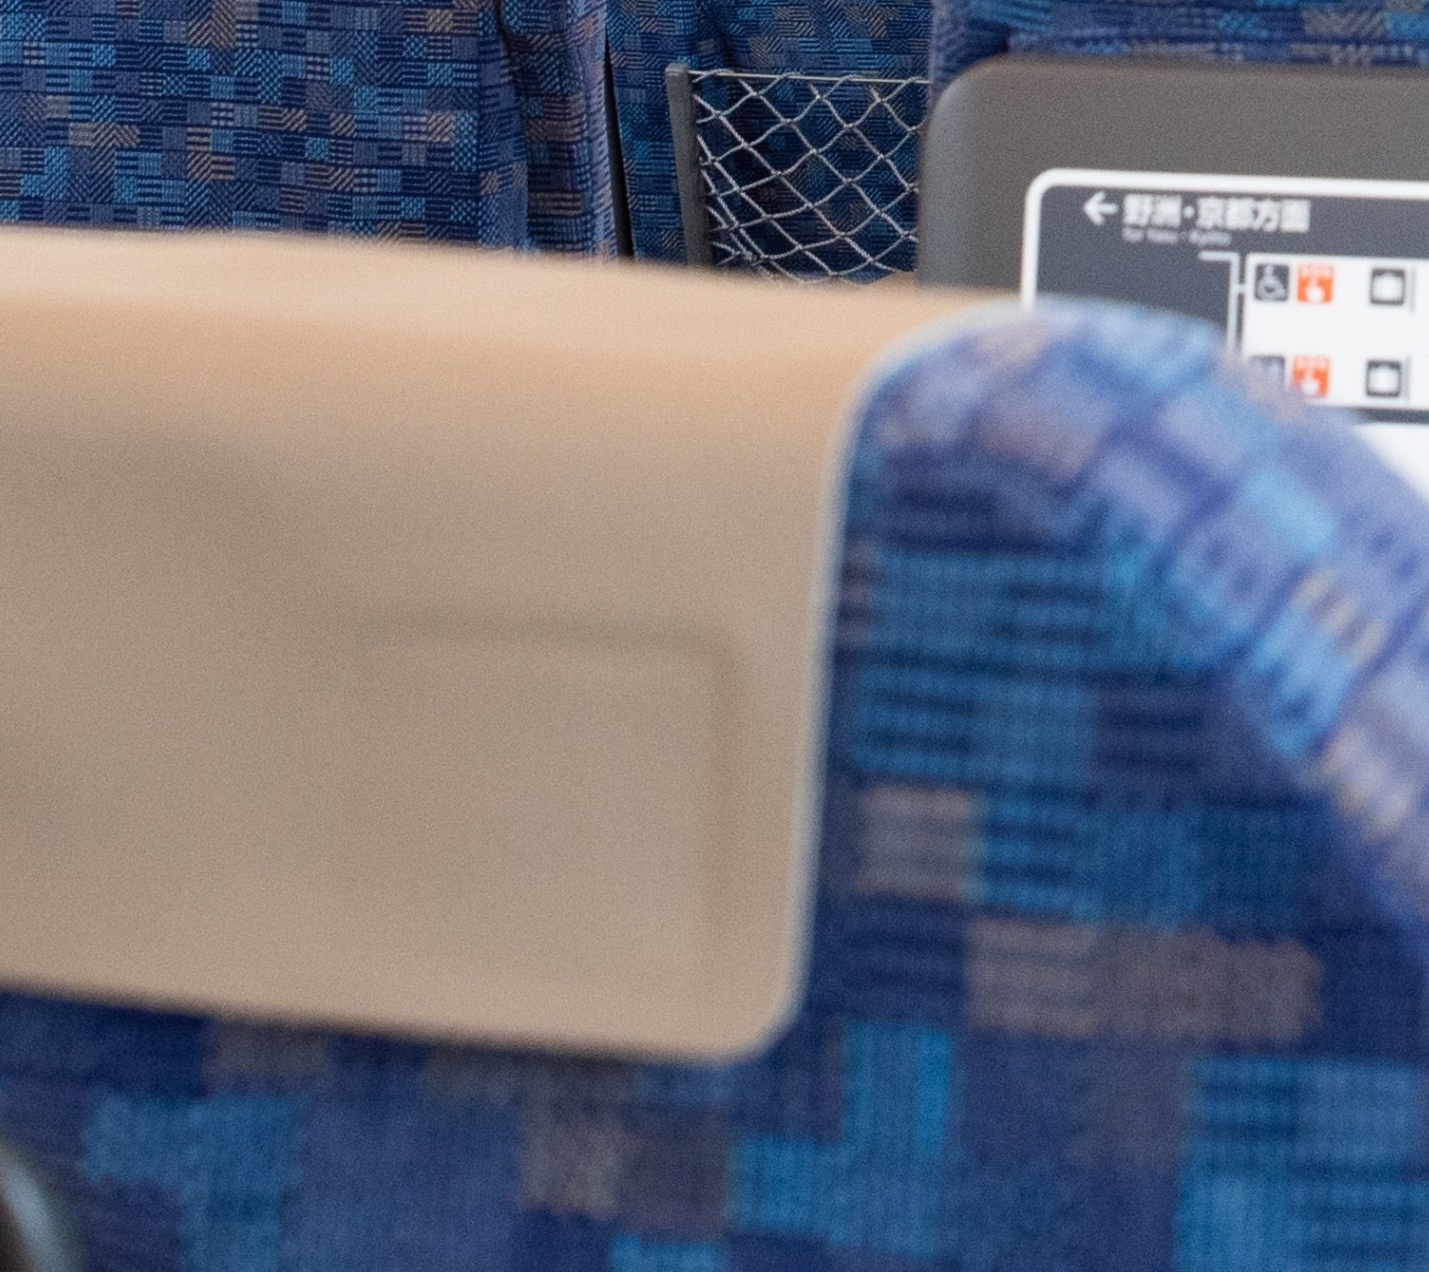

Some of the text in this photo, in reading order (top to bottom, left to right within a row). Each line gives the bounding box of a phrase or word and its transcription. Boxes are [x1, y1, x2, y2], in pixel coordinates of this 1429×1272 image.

[1122, 193, 1310, 234] 野洲・京都方面
